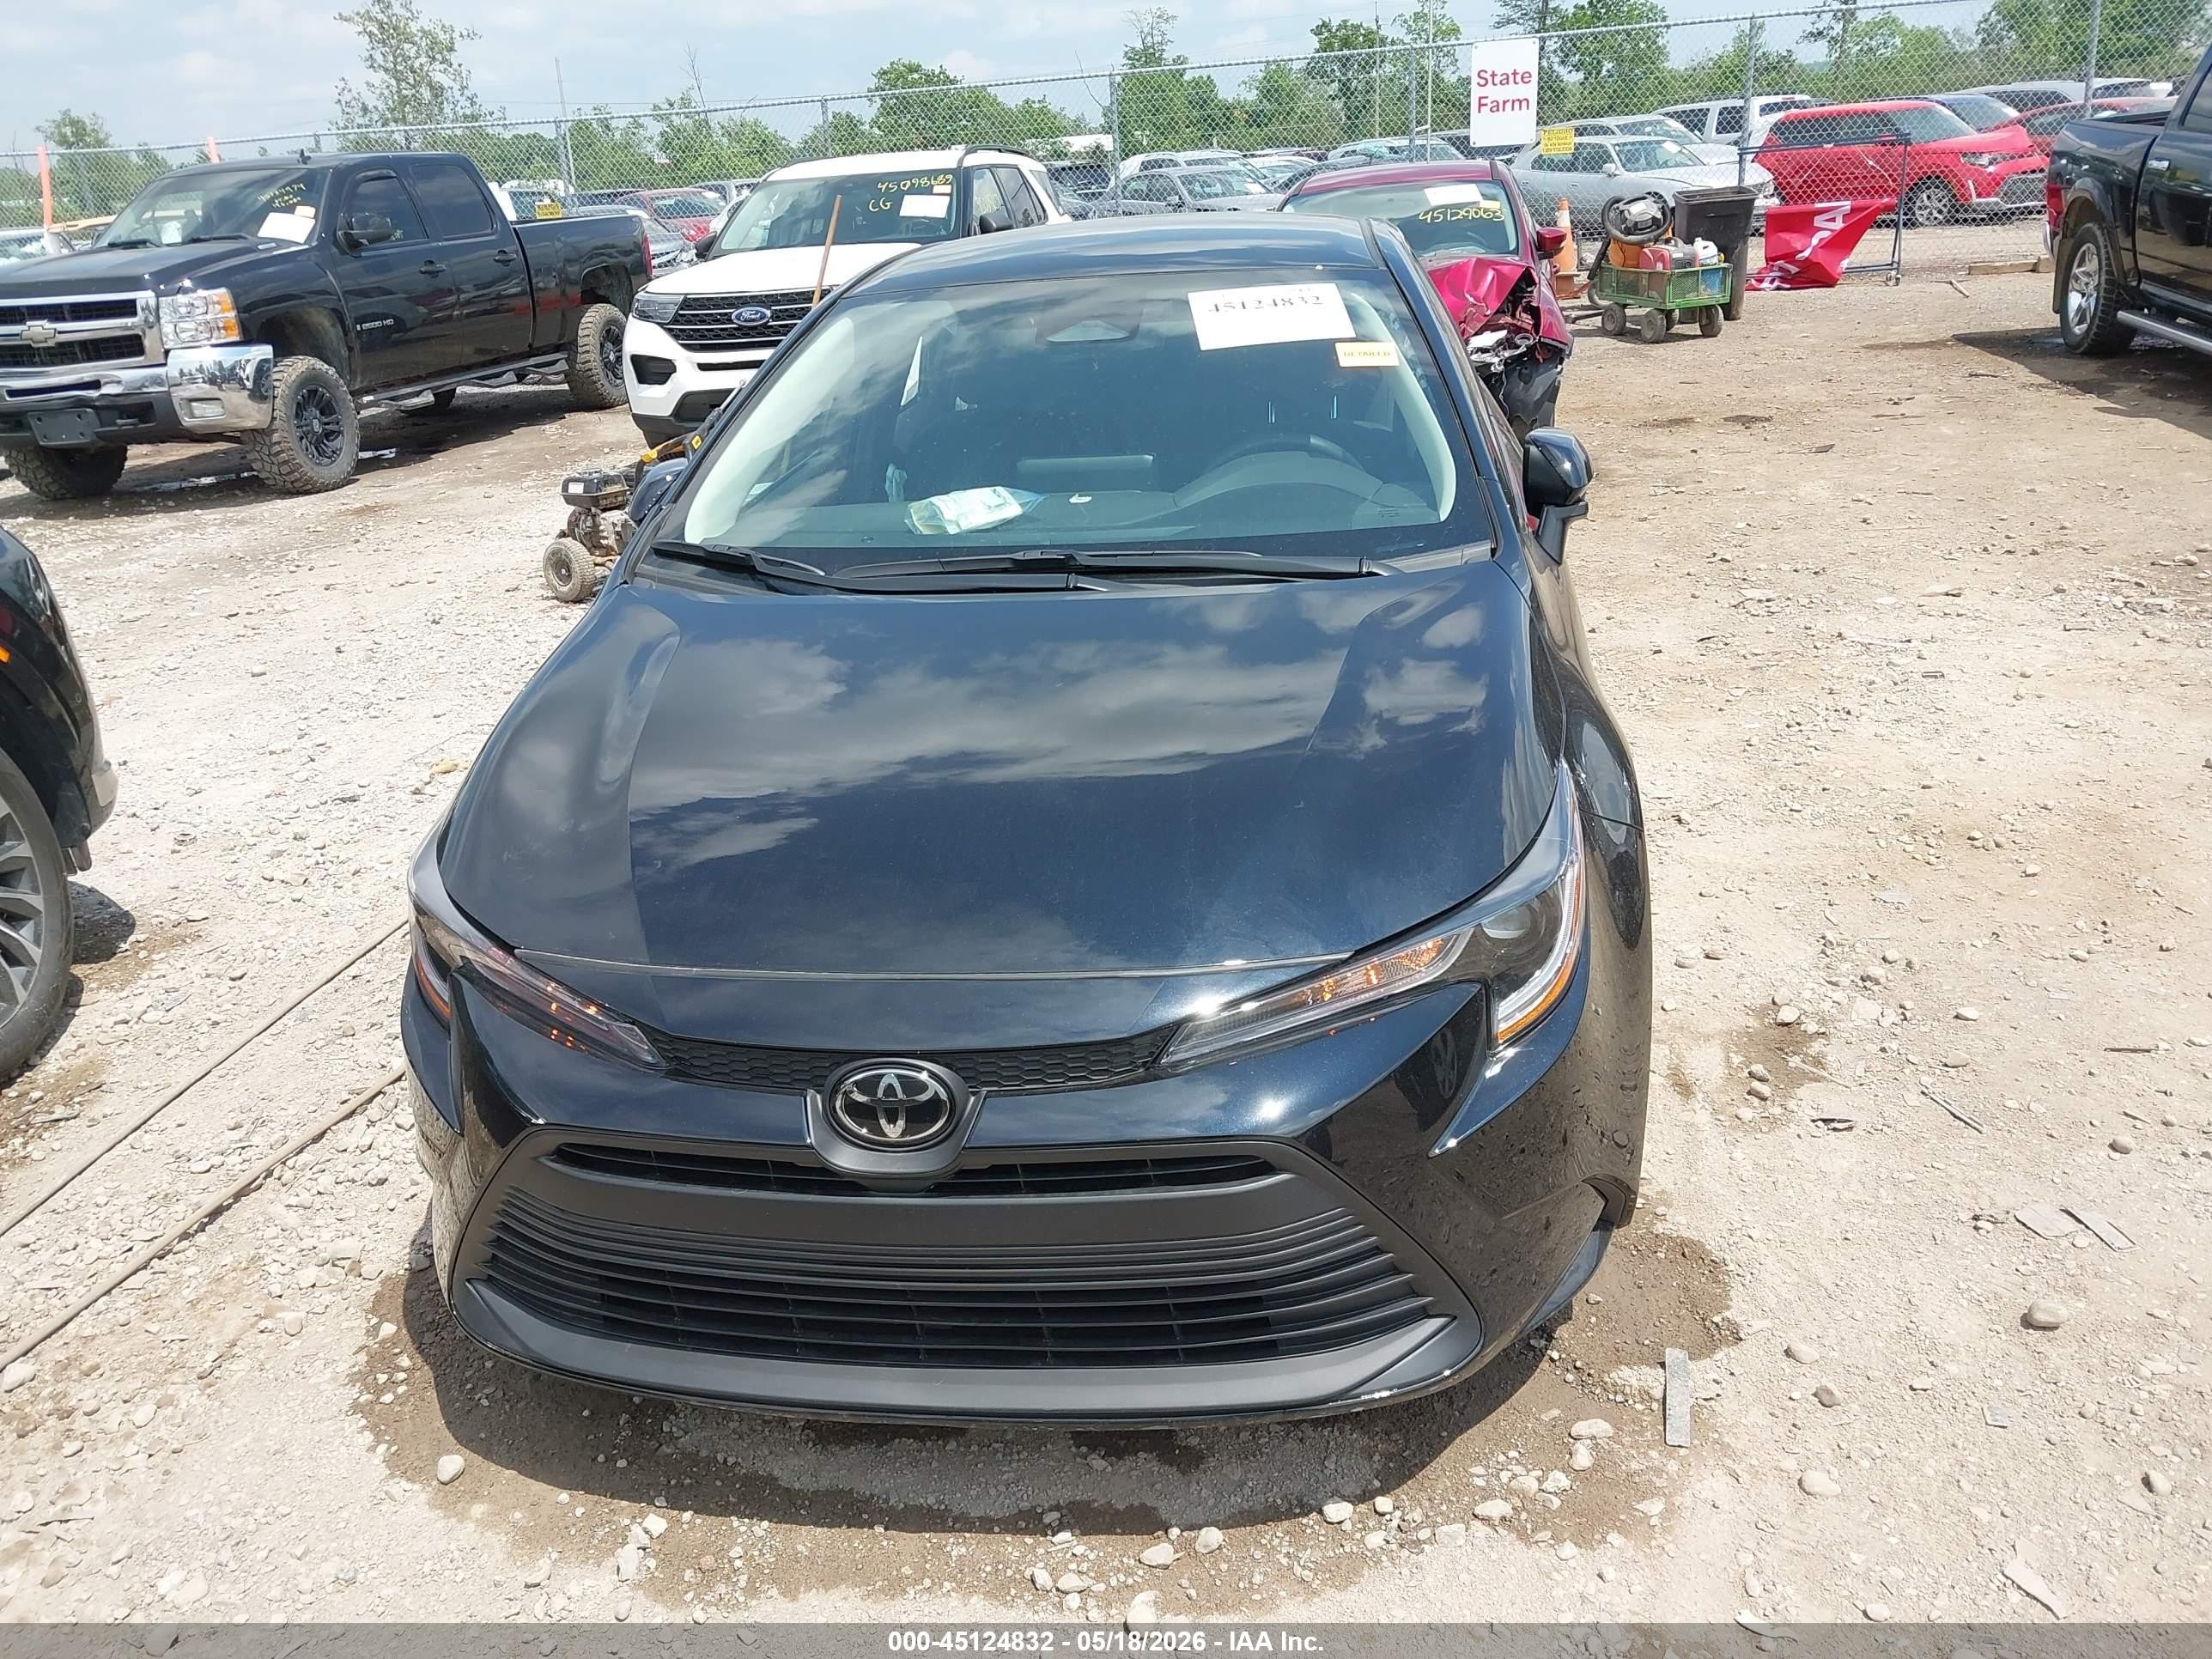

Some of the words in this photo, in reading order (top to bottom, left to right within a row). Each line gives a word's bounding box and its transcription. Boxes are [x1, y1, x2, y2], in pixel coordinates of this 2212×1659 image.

[1477, 69, 1532, 87] State
[1478, 95, 1529, 113] Farm
[878, 174, 953, 193] 45098689
[868, 197, 893, 212] CG
[1419, 207, 1505, 223] 45129063
[1208, 295, 1323, 313] 45124832
